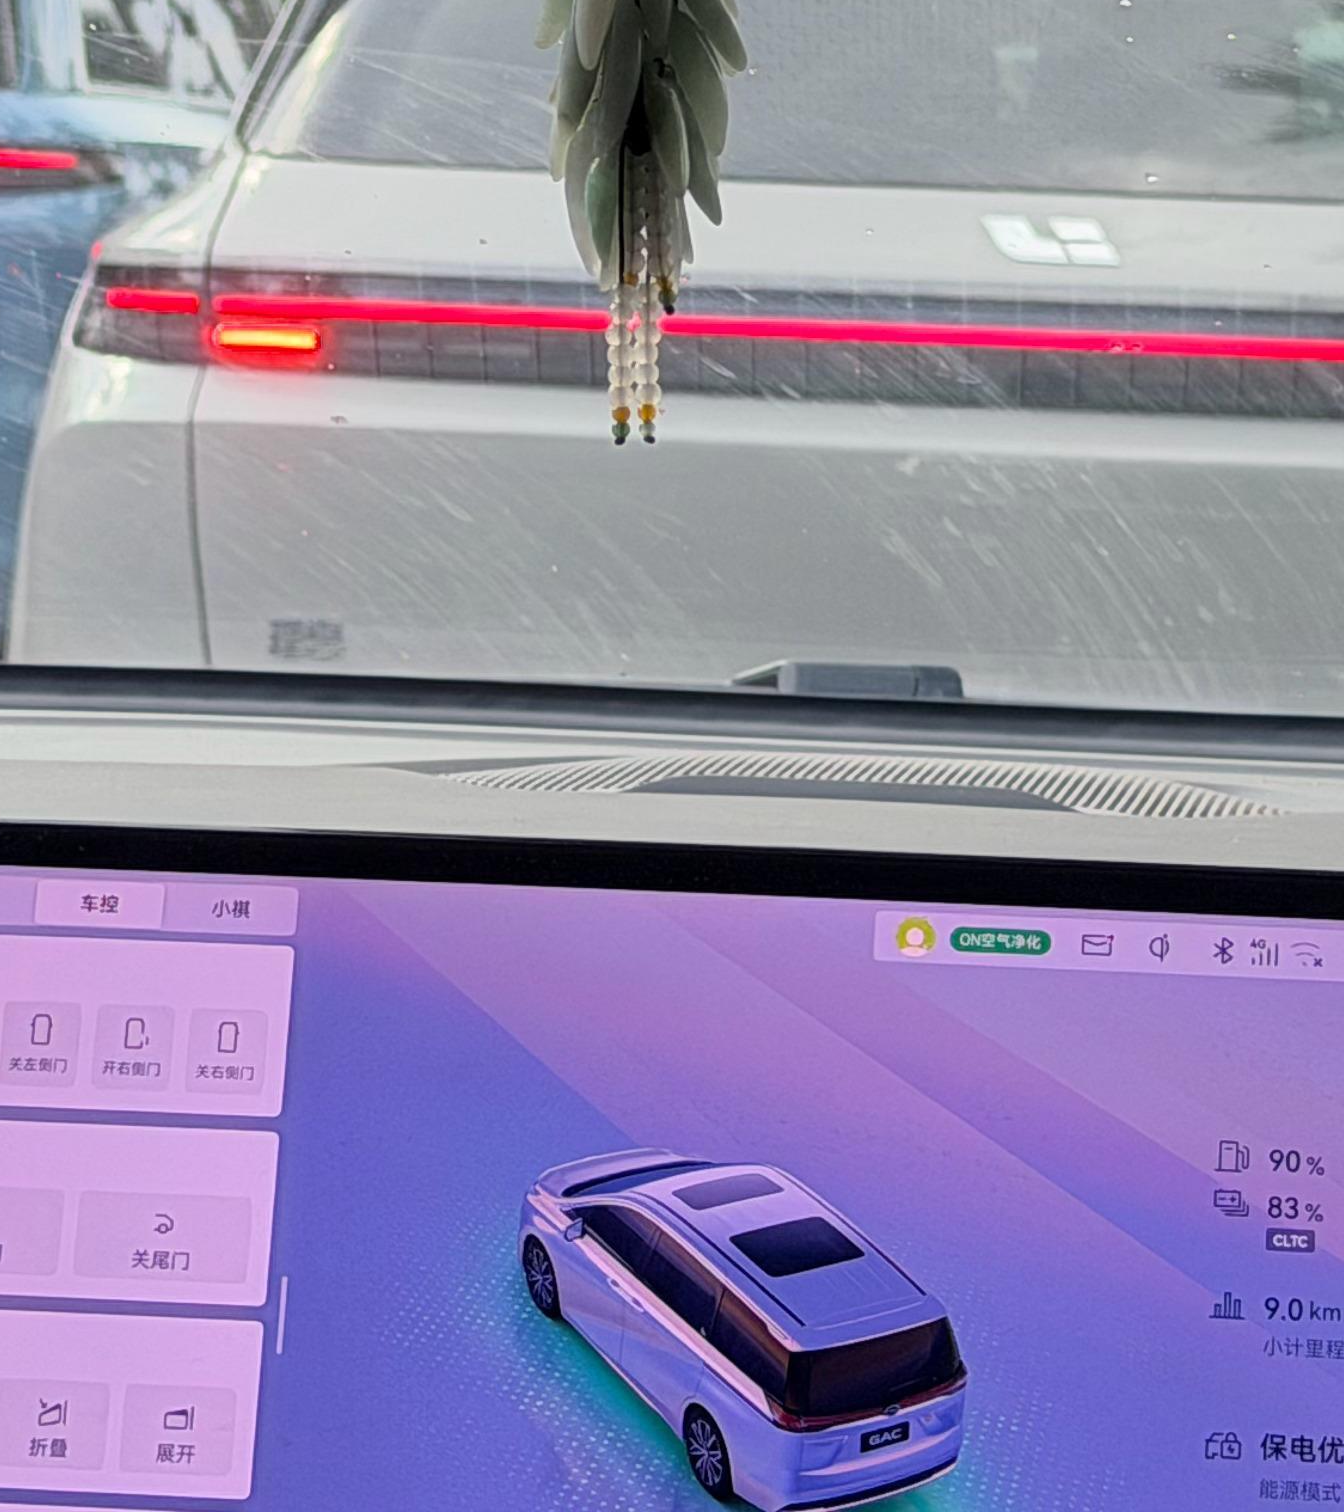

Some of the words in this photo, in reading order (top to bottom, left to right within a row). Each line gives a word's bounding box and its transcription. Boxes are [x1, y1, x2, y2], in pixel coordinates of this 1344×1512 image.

[80, 893, 119, 914] 车控
[211, 899, 251, 919] 小祺
[8, 1056, 68, 1074] 关左侧门
[101, 1060, 162, 1078] 开右侧门
[194, 1064, 255, 1082] 关右侧门
[1272, 1234, 1309, 1249] CLTC
[131, 1249, 191, 1271] 关尾门
[1263, 1297, 1304, 1322] 9.0
[868, 1427, 903, 1447] GAC
[29, 1437, 68, 1458] 折叠
[156, 1443, 195, 1464] 展开
[1258, 1479, 1342, 1503] 能源模式
